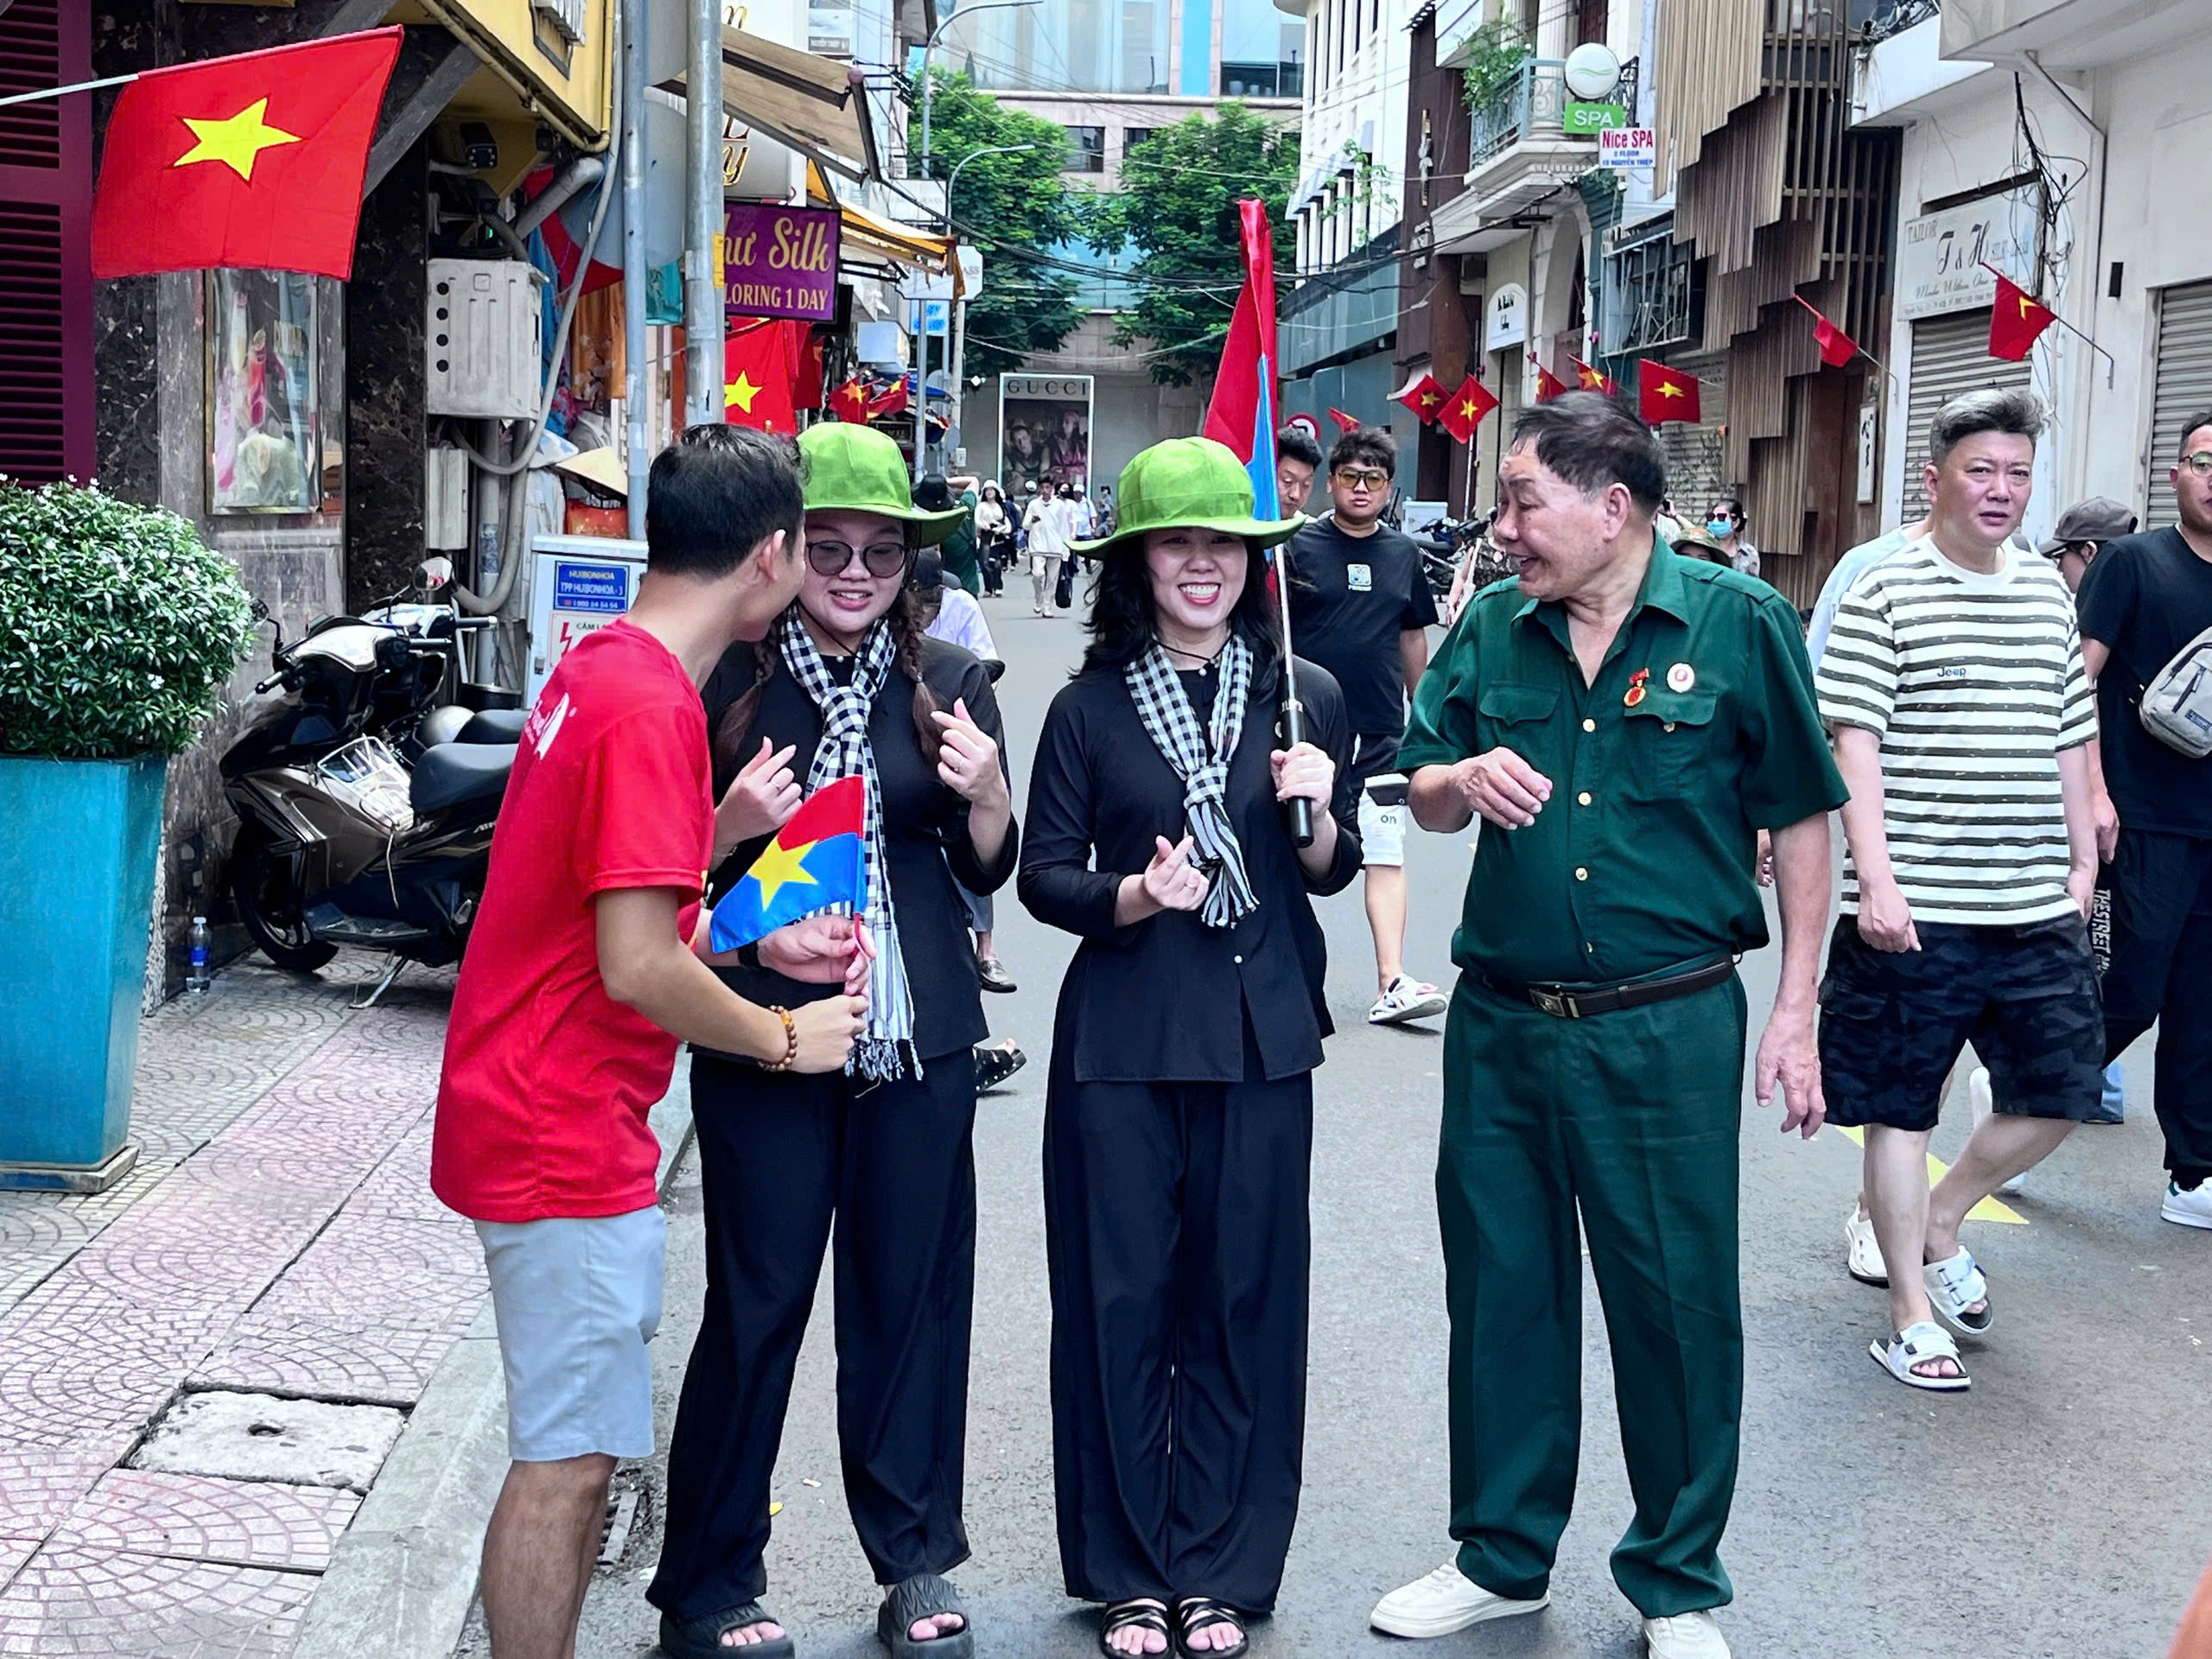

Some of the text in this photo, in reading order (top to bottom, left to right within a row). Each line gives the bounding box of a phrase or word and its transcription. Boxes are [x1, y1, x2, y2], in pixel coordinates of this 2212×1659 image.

[1573, 110, 1614, 127] SPA
[1602, 130, 1653, 148] Nice SPA
[1907, 219, 1939, 245] TAILOR
[768, 216, 832, 272] Silk
[785, 287, 793, 309] 1
[798, 288, 829, 311] DAY
[1007, 379, 1086, 396] GUCCI
[1936, 664, 1967, 677] Jeep
[1380, 814, 1397, 825] on
